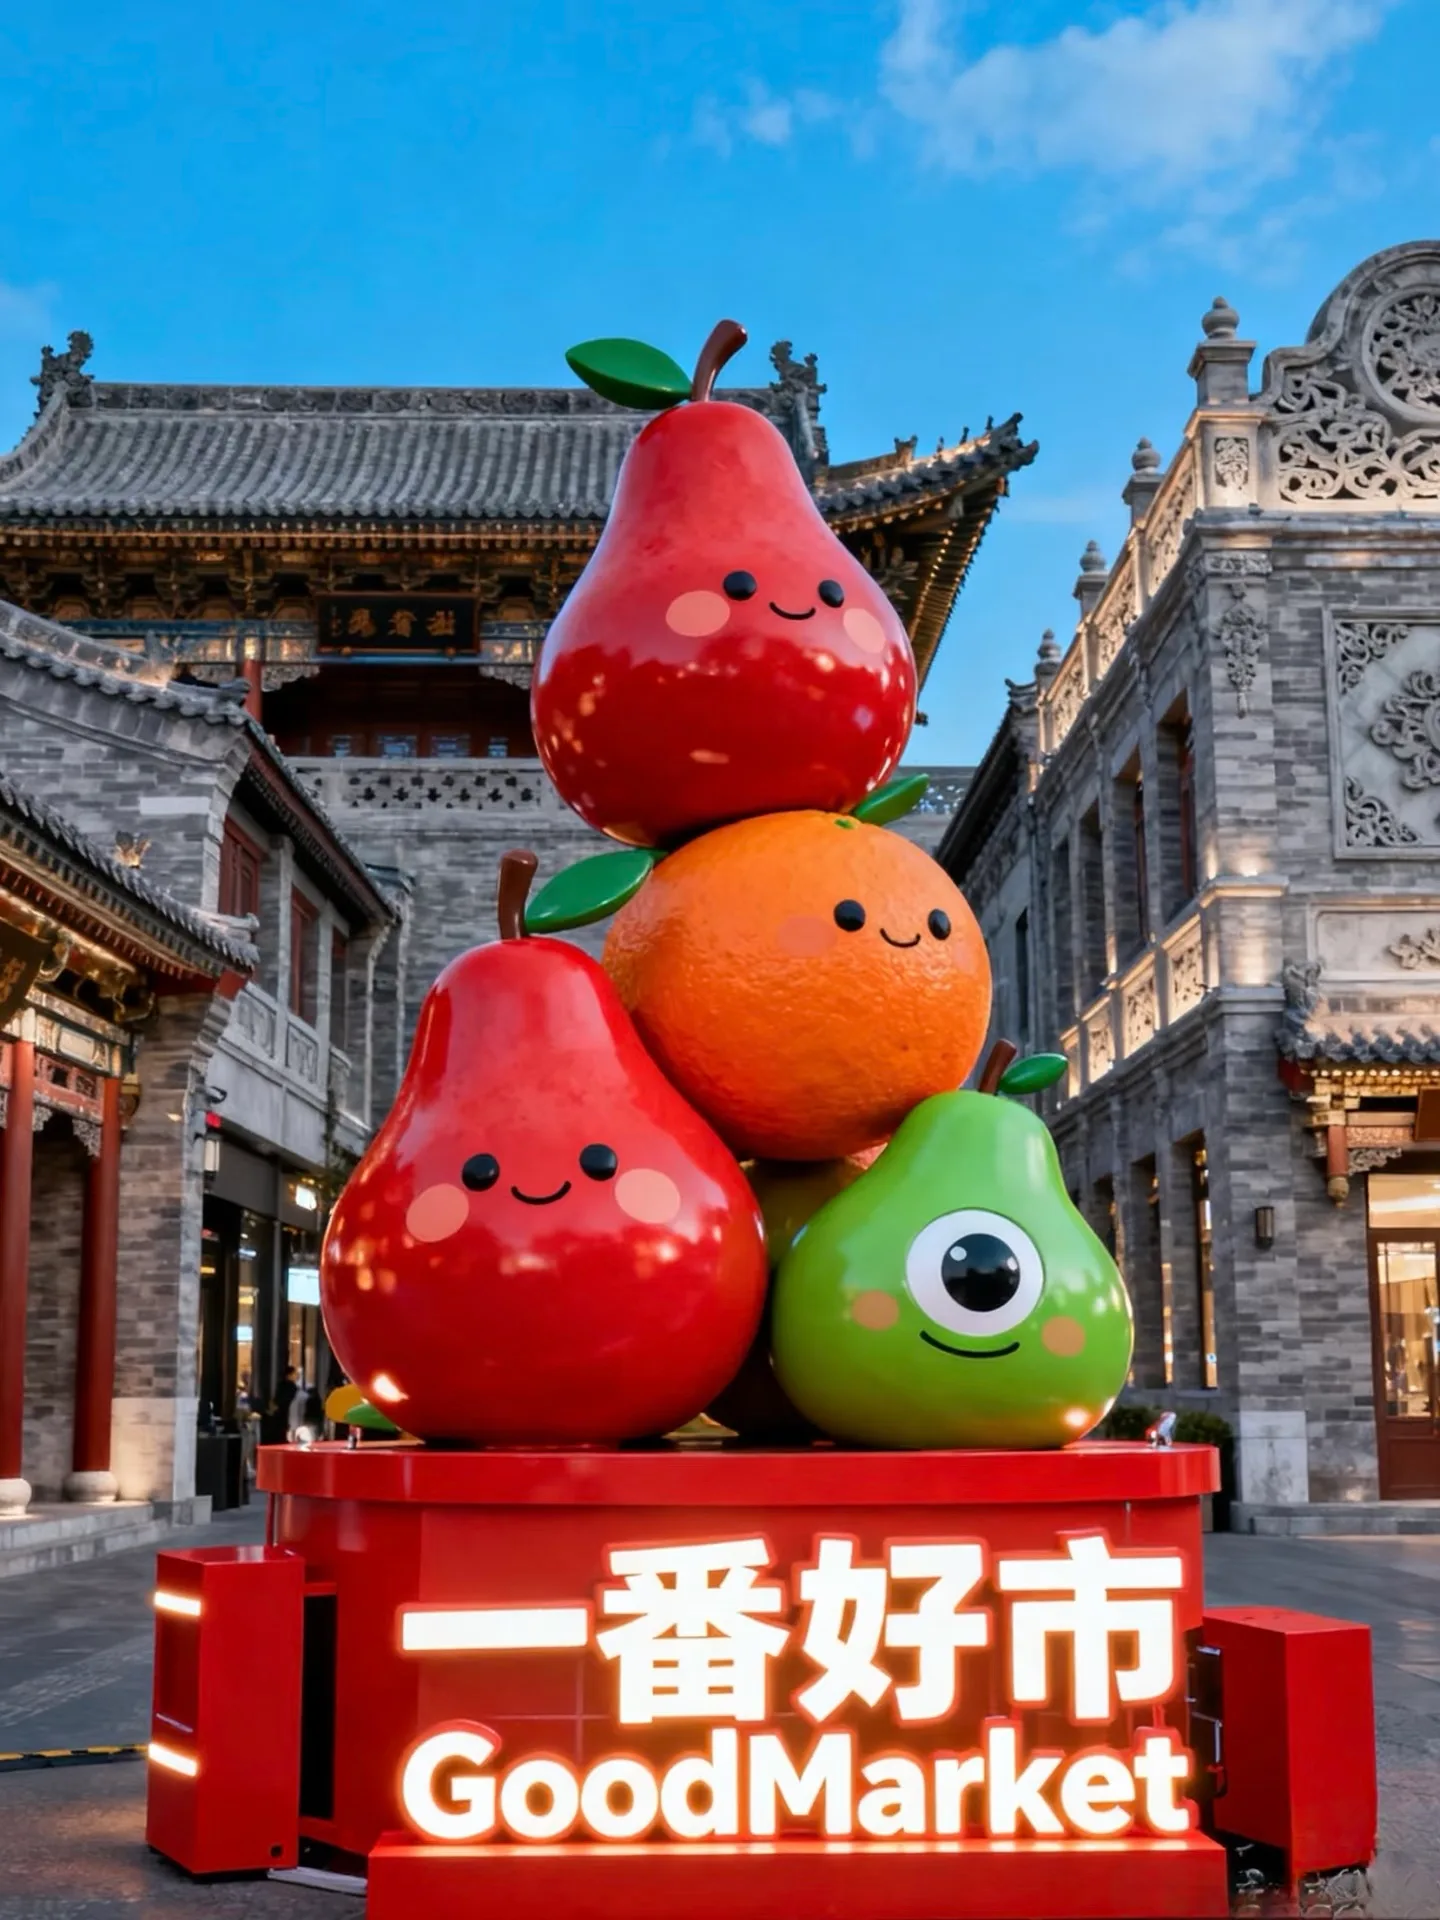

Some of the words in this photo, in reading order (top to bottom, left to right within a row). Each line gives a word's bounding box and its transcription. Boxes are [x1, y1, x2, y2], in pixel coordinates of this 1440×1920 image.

[402, 1535, 1183, 1723] 一番好市
[402, 1726, 1189, 1839] GoodMarket
